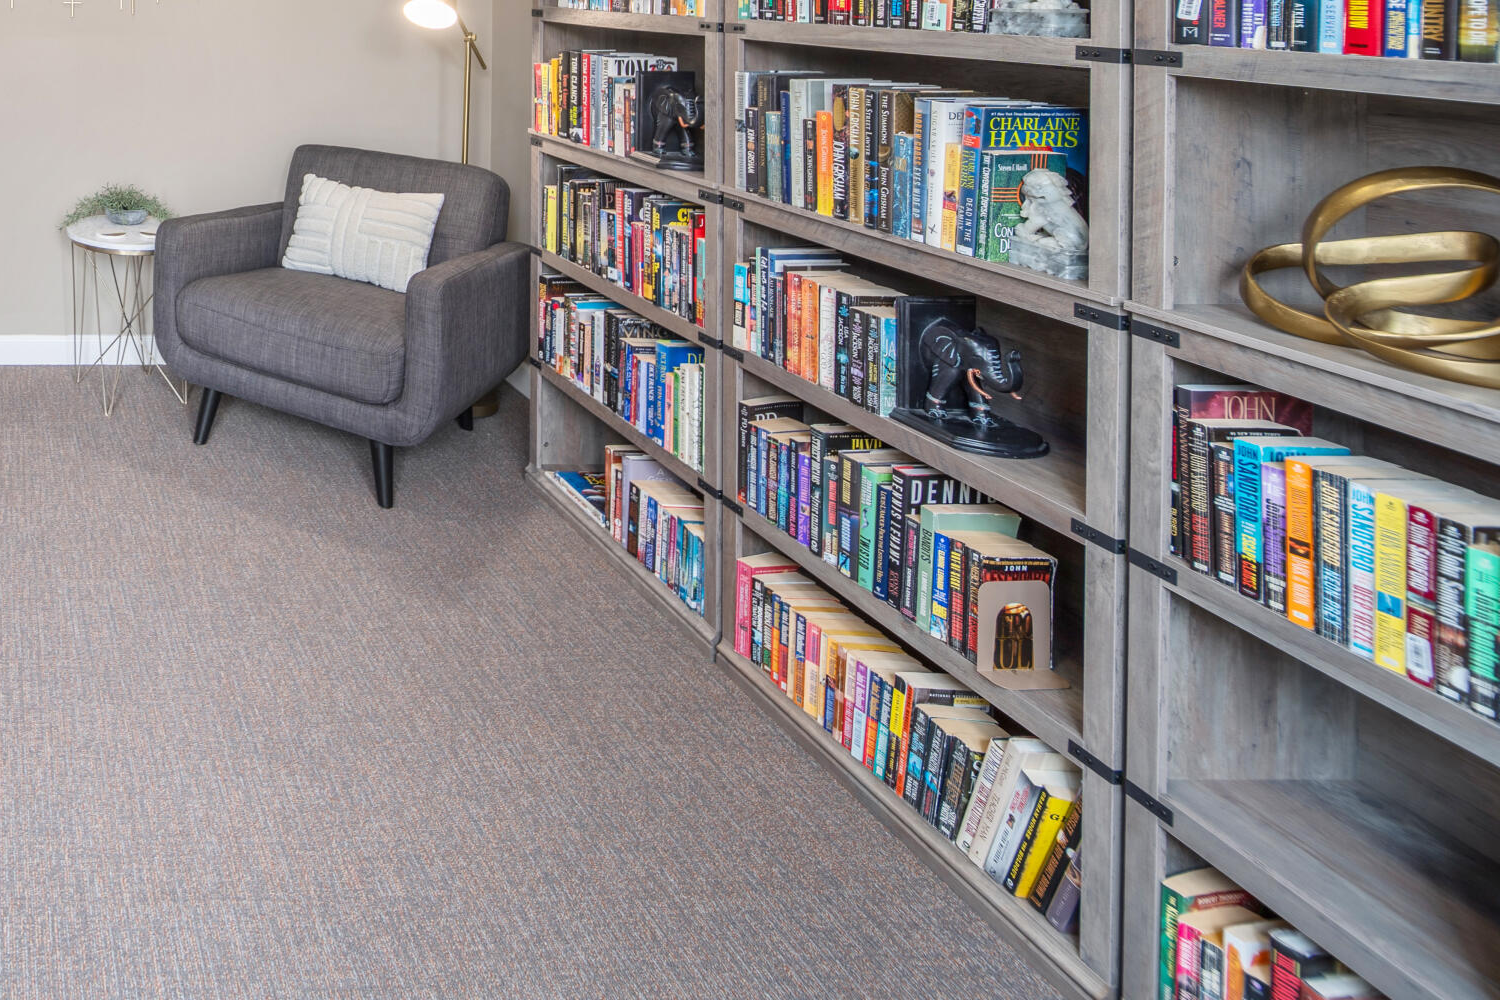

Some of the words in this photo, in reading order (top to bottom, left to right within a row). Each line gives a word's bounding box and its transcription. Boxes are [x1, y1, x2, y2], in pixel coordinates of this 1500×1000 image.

[571, 57, 579, 75] TOM
[570, 75, 578, 107] CLANCY
[849, 89, 860, 110] JOHN
[881, 95, 889, 109] THE
[849, 111, 861, 146] GRISHAM
[880, 109, 890, 145] SUMMONS
[988, 130, 1079, 148] HARRIS
[989, 117, 1081, 131] CHARLAINE
[832, 140, 846, 162] JOHN
[832, 162, 846, 201] GRISHAM
[880, 166, 890, 186] JOHN
[879, 186, 890, 219] GRISHAM
[965, 197, 974, 217] DEAD
[963, 227, 972, 242] THE
[1224, 396, 1276, 422] JOHN
[1237, 445, 1259, 461] JOHN
[890, 474, 904, 519] DENNIS
[1236, 459, 1259, 524] SANDFORD
[1321, 480, 1342, 512] JOHN
[858, 535, 871, 571] TWISTED
[888, 521, 901, 566] LEHANE
[921, 528, 933, 565] BANDITS
[1241, 533, 1257, 562] ESCAPE
[1321, 511, 1342, 568] SANDFORD
[1350, 502, 1375, 575] SANDFORD
[1241, 560, 1258, 591] CLAUSE
[1322, 566, 1342, 601] NEON
